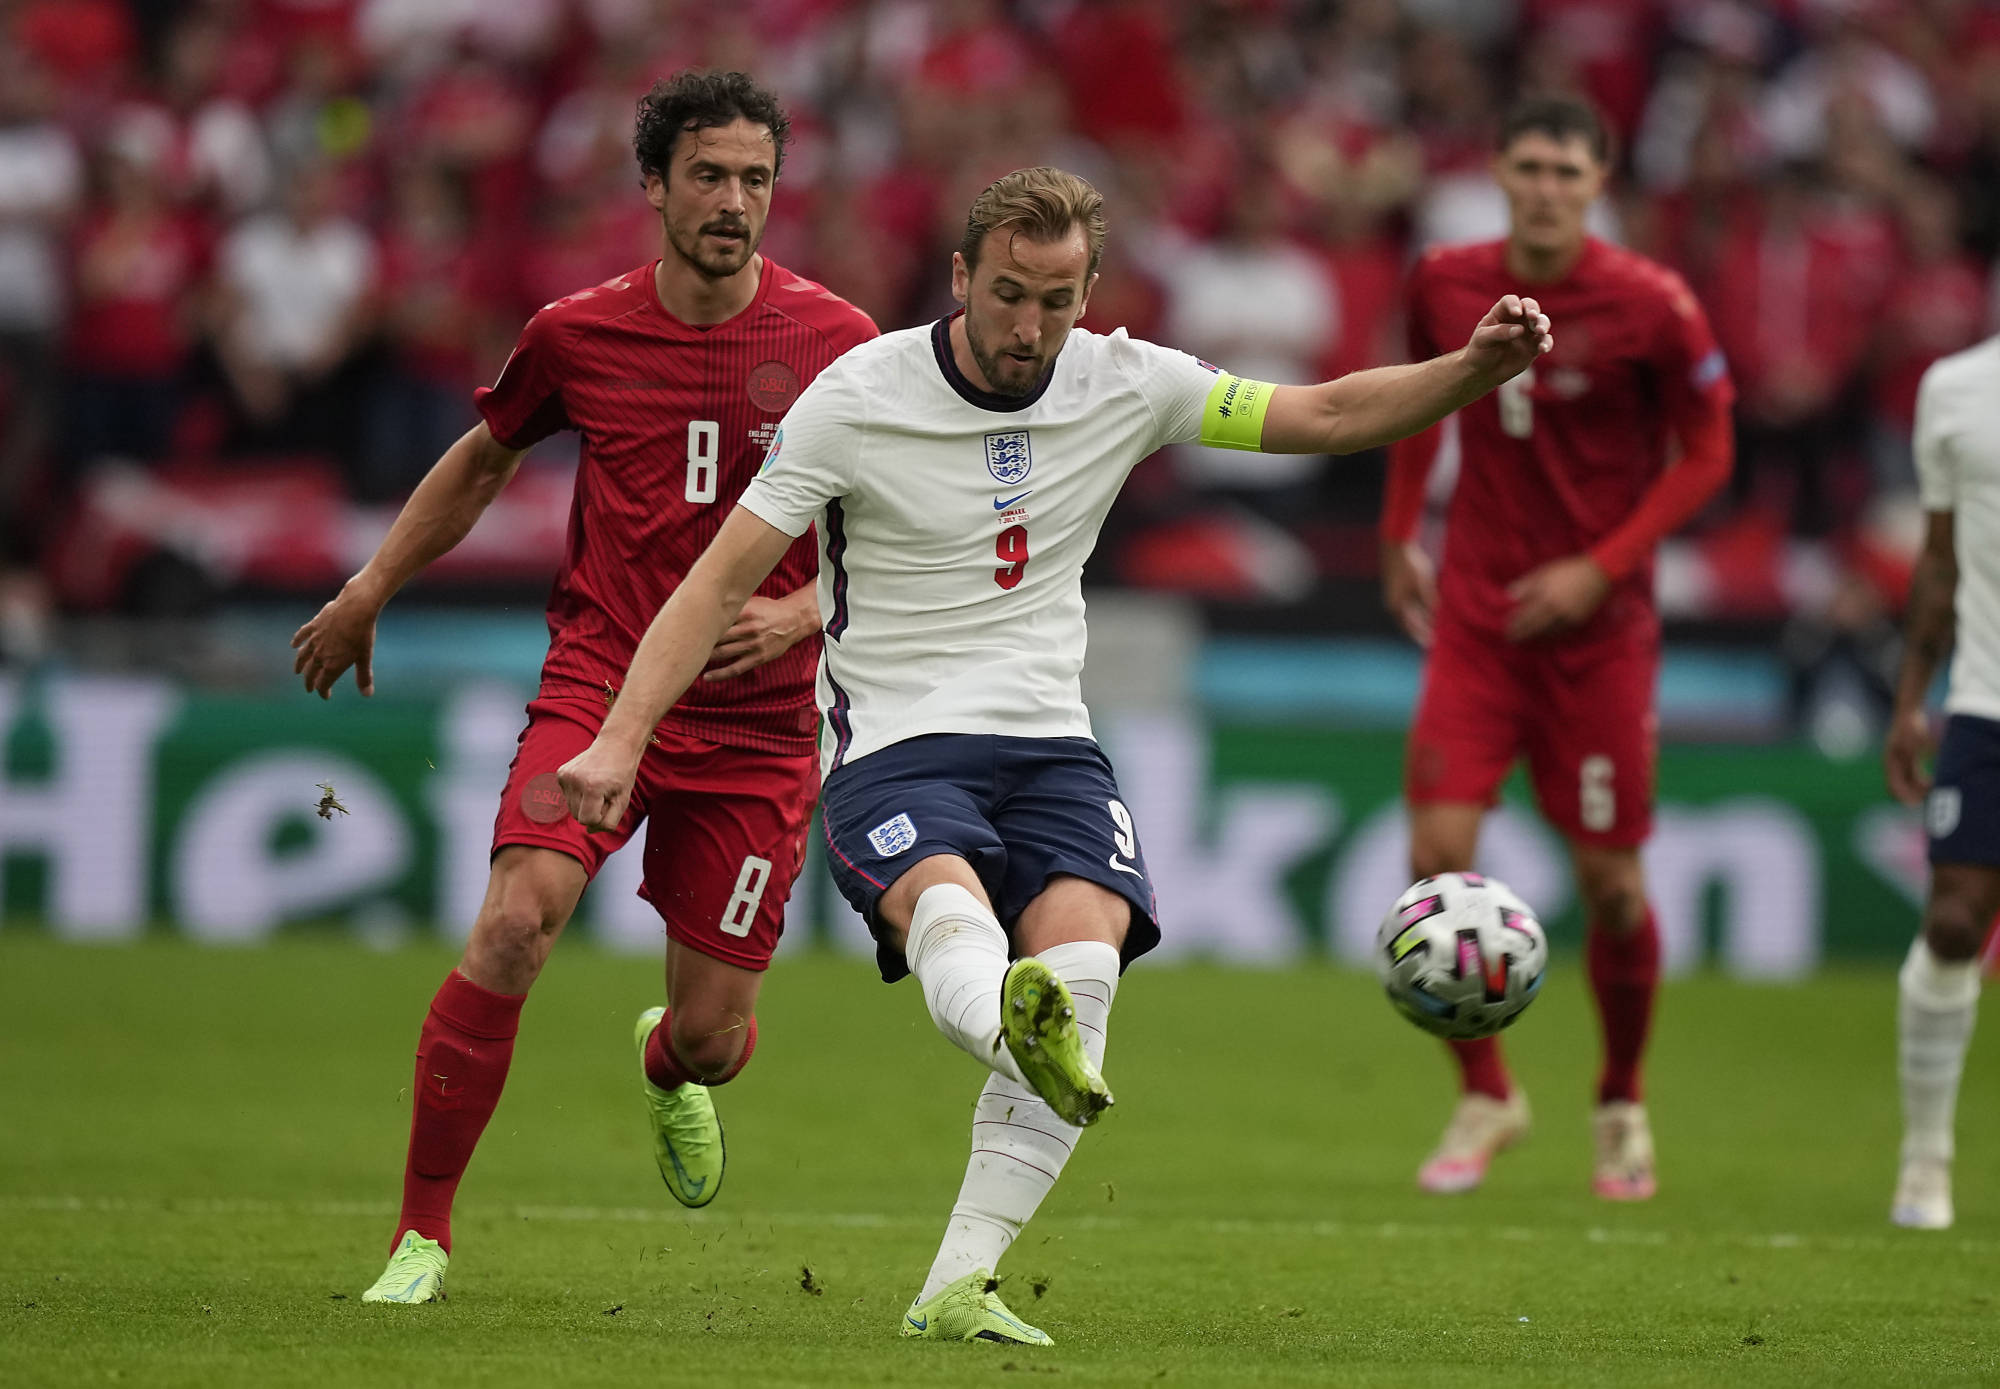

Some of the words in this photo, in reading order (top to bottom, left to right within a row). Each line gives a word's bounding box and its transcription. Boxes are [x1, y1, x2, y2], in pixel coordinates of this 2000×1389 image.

[759, 378, 787, 393] DBU
[1244, 382, 1258, 401] RES
[685, 420, 720, 504] 8
[994, 525, 1028, 590] 9
[0, 678, 1820, 983] Heiken
[1107, 800, 1136, 860] 9
[719, 855, 772, 938] 8
